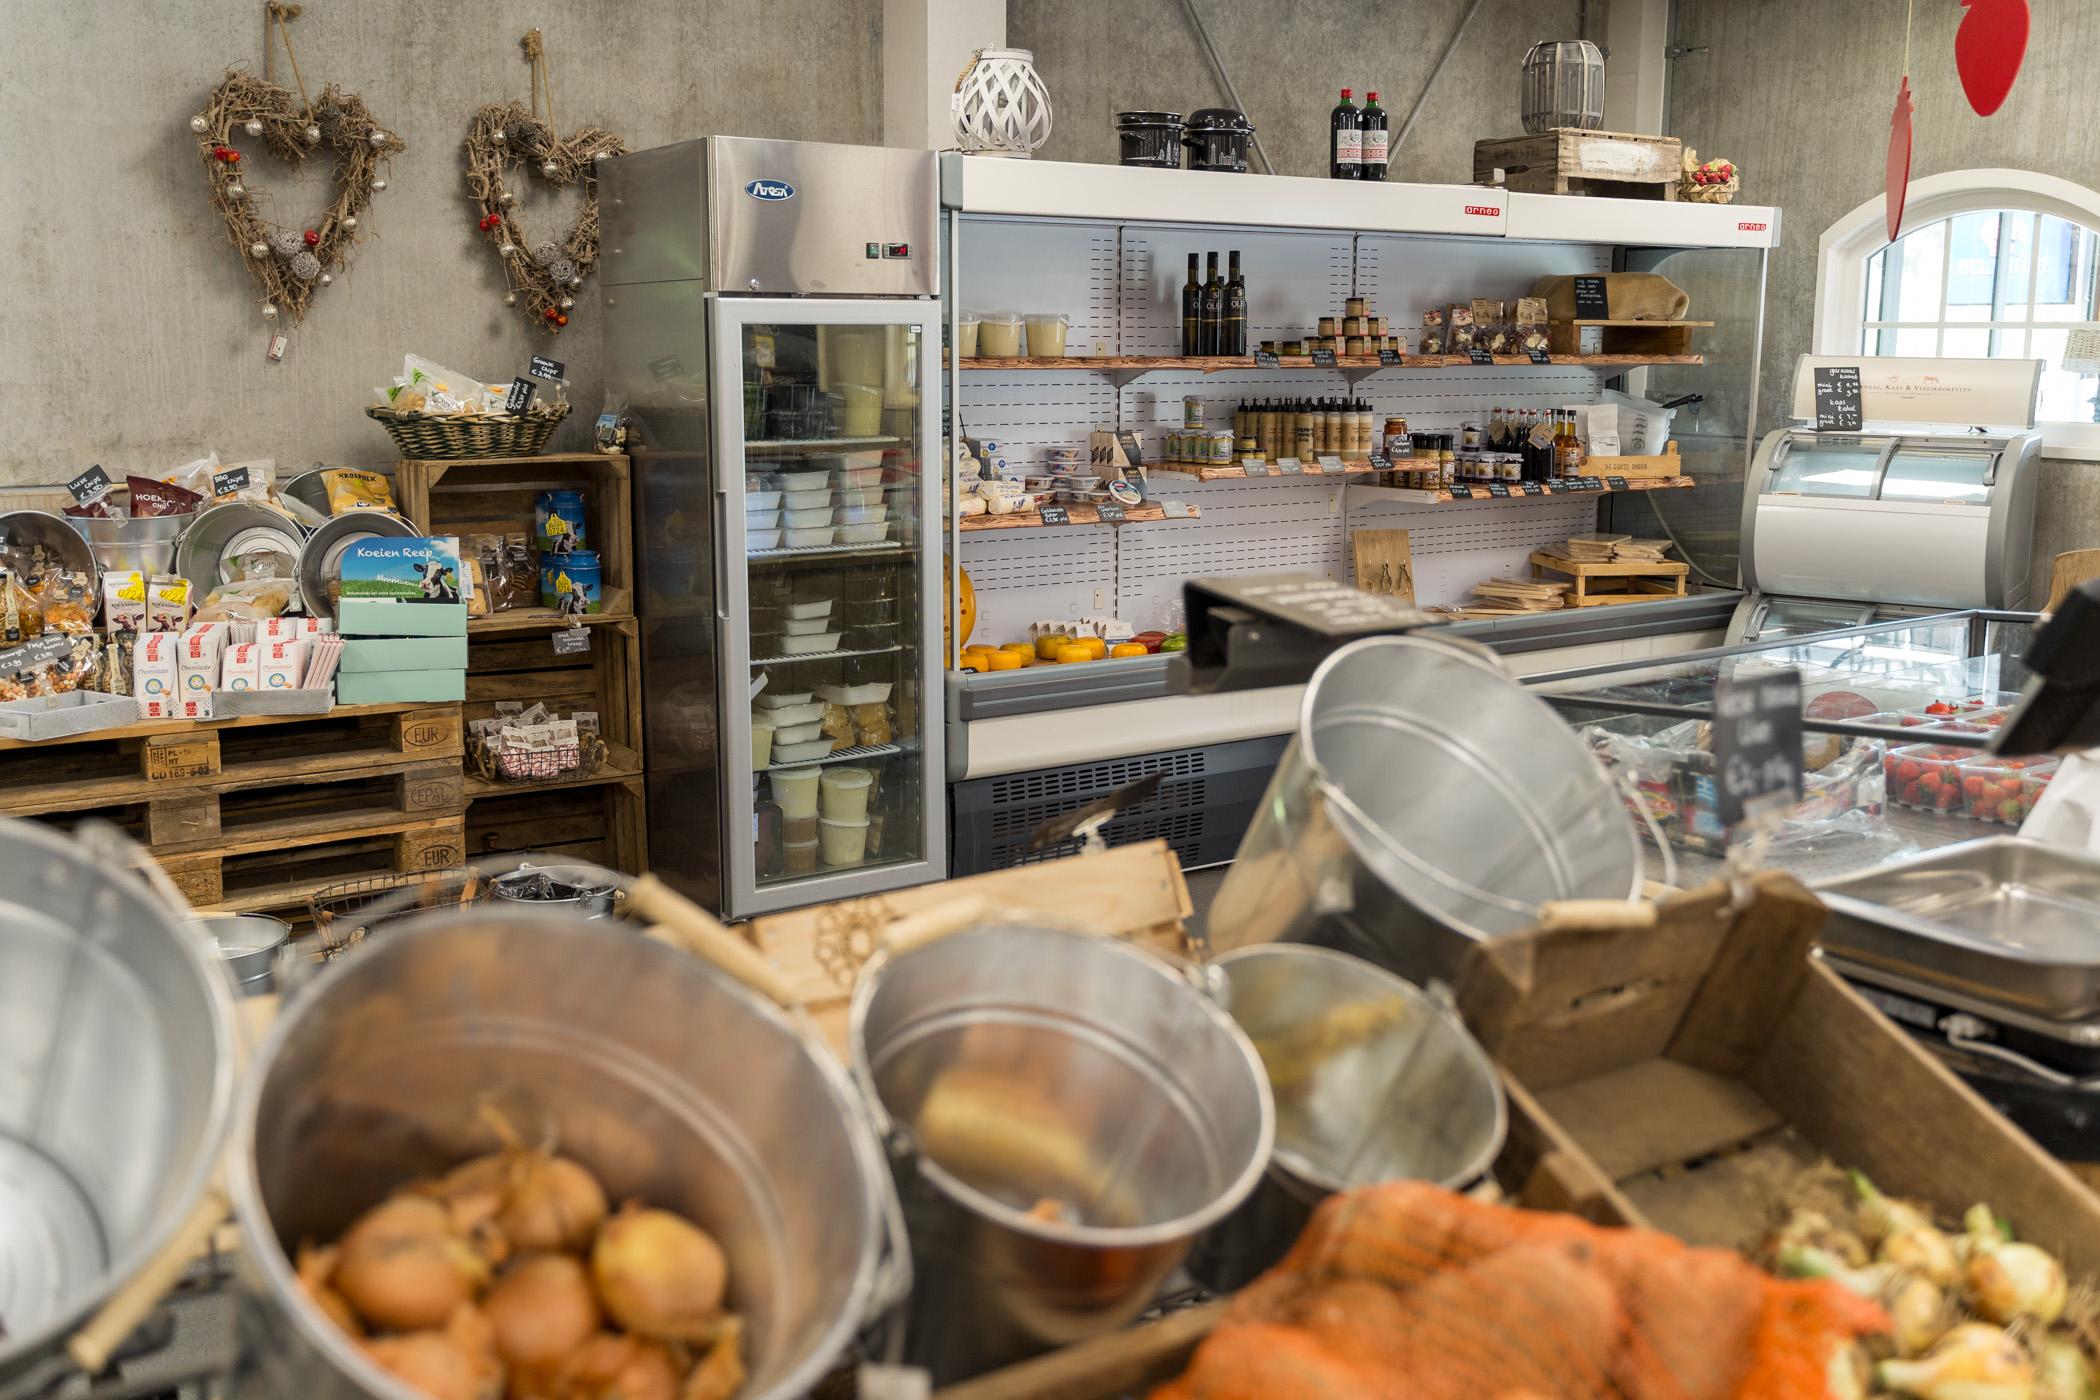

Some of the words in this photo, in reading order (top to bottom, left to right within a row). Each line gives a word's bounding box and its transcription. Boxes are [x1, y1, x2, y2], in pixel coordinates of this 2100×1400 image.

[357, 547, 399, 558] Koeien
[402, 548, 433, 562] Reep
[414, 727, 439, 743] EUR
[424, 850, 451, 867] EUR
